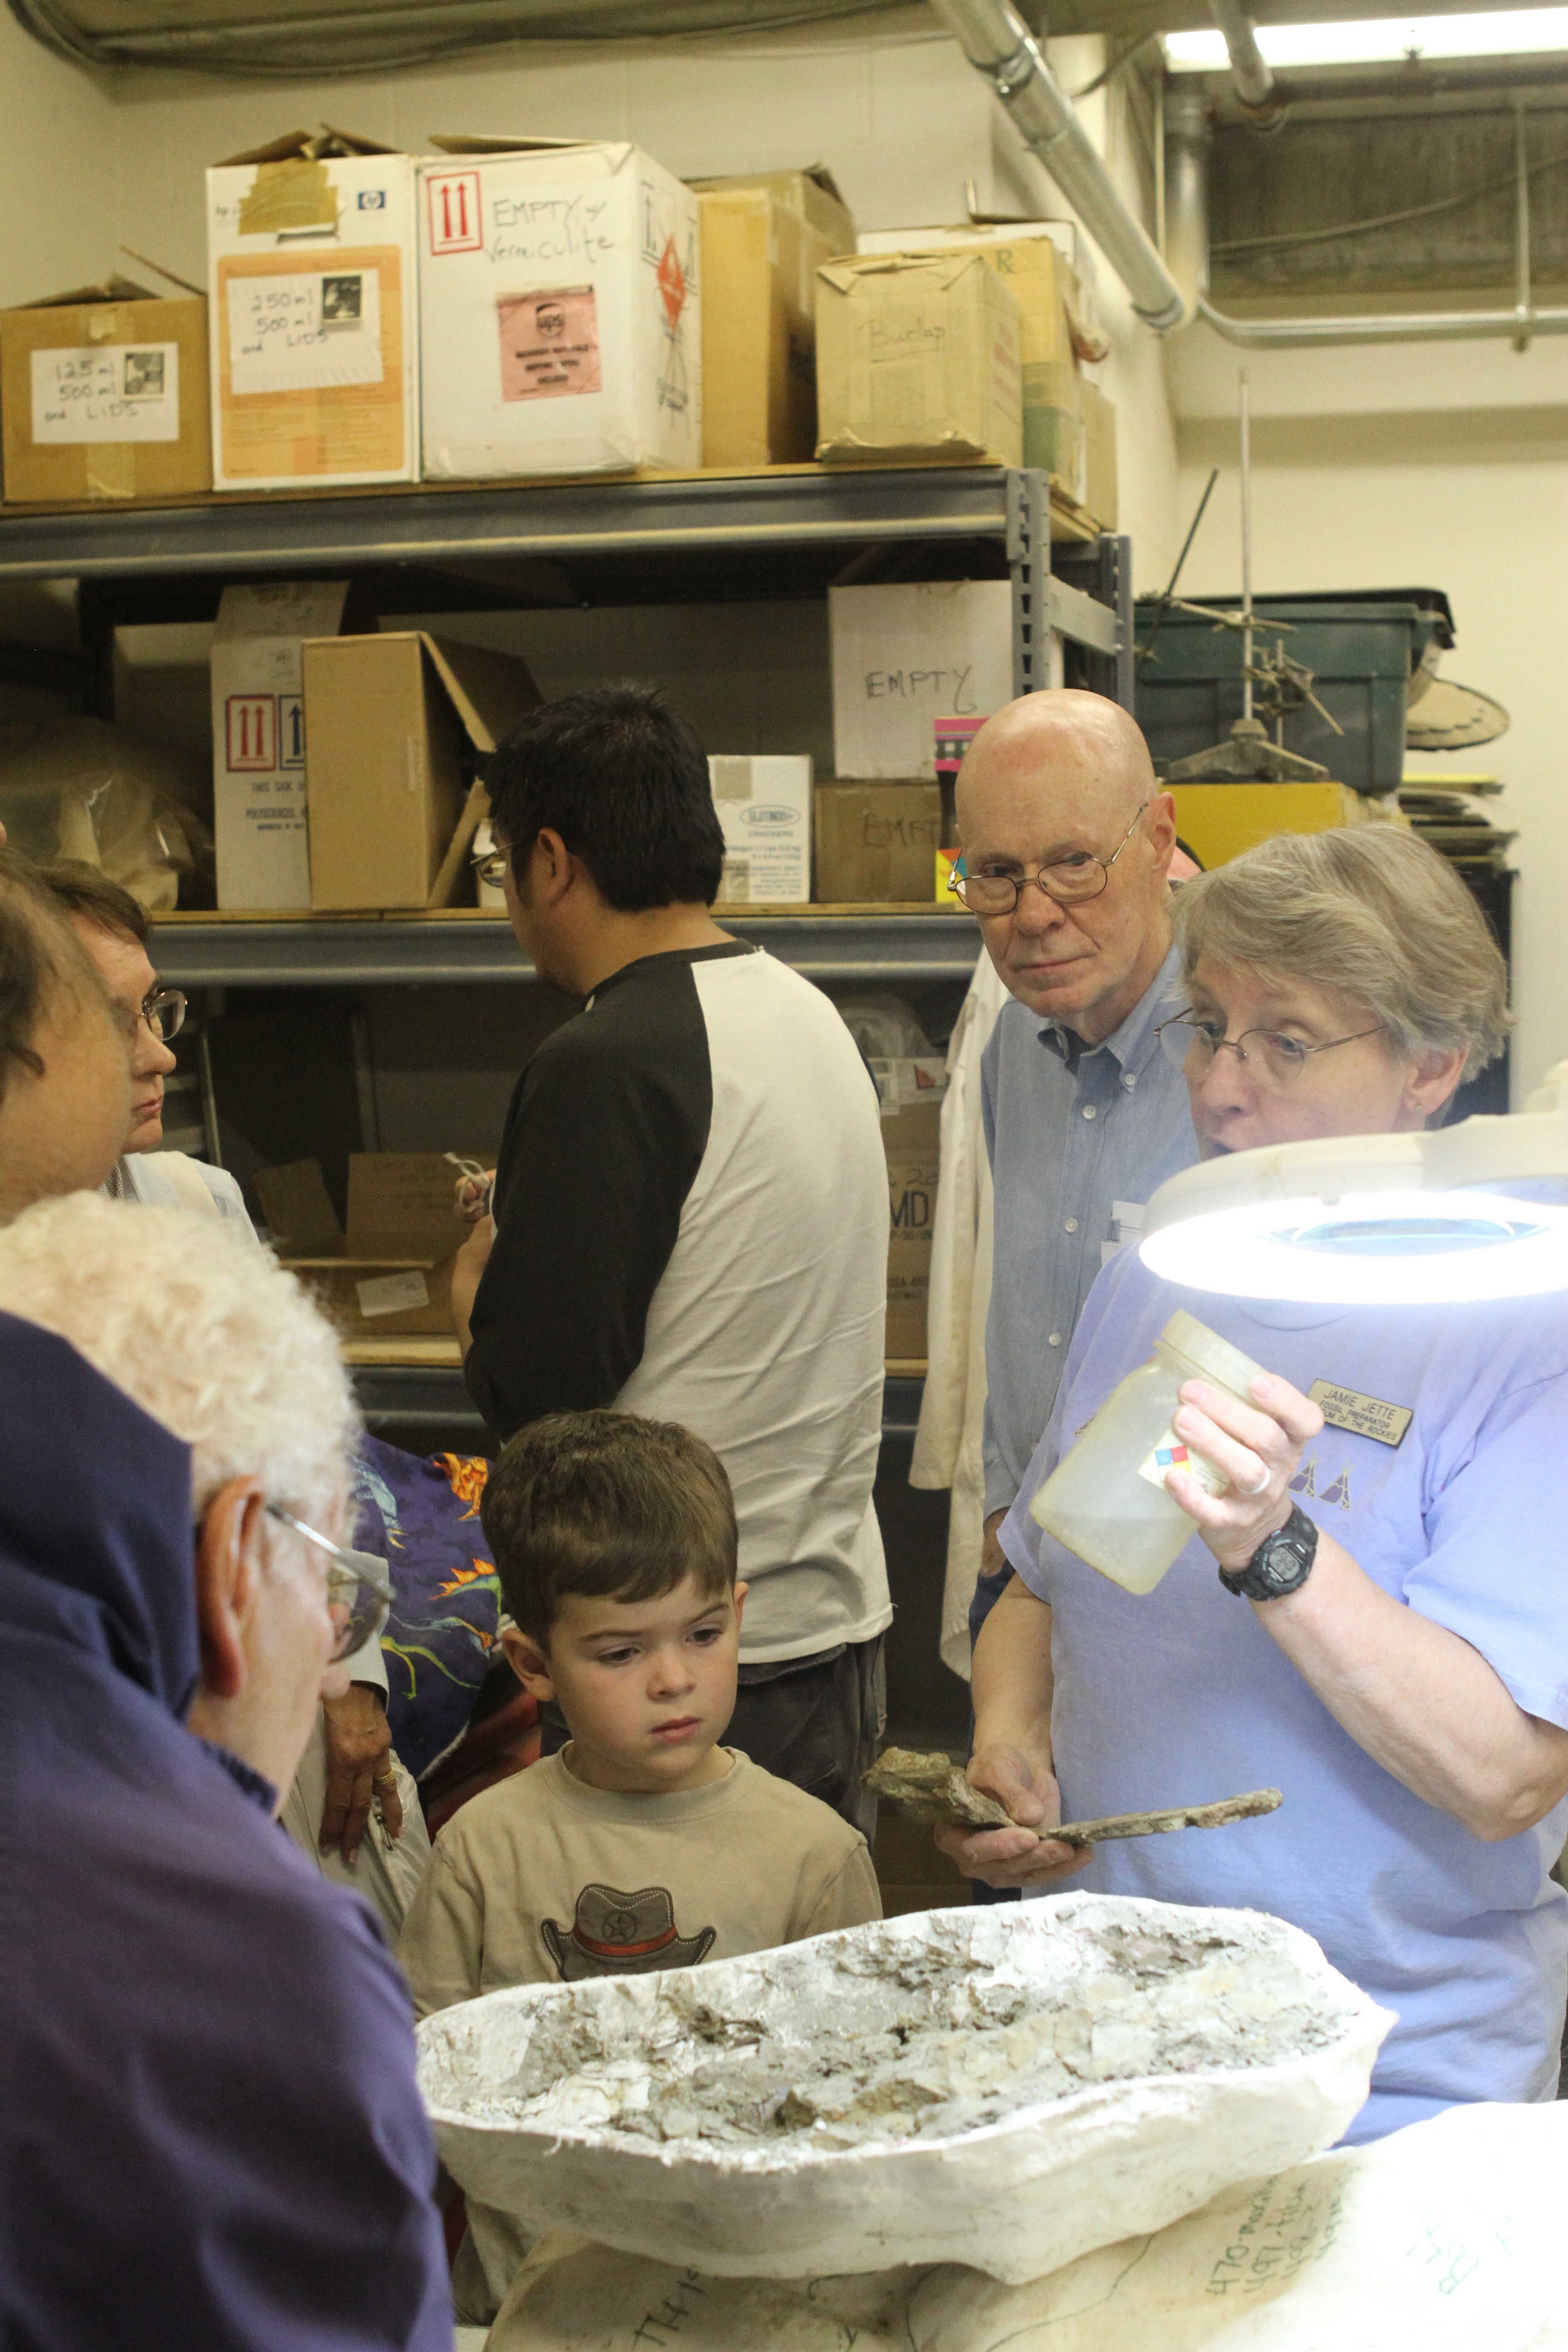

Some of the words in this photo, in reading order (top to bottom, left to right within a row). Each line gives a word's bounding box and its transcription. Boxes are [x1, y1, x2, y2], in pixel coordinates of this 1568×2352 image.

[493, 194, 583, 226] EMPTY
[865, 665, 978, 714] EMPTY
[1320, 1400, 1343, 1413] FOSSIL
[1348, 1409, 1391, 1429] PREPARATOR
[1324, 1389, 1358, 1407] JAMIE
[1361, 1401, 1397, 1420] JETTE
[1352, 1419, 1365, 1429] THE
[1368, 1425, 1397, 1441] ROCKIES
